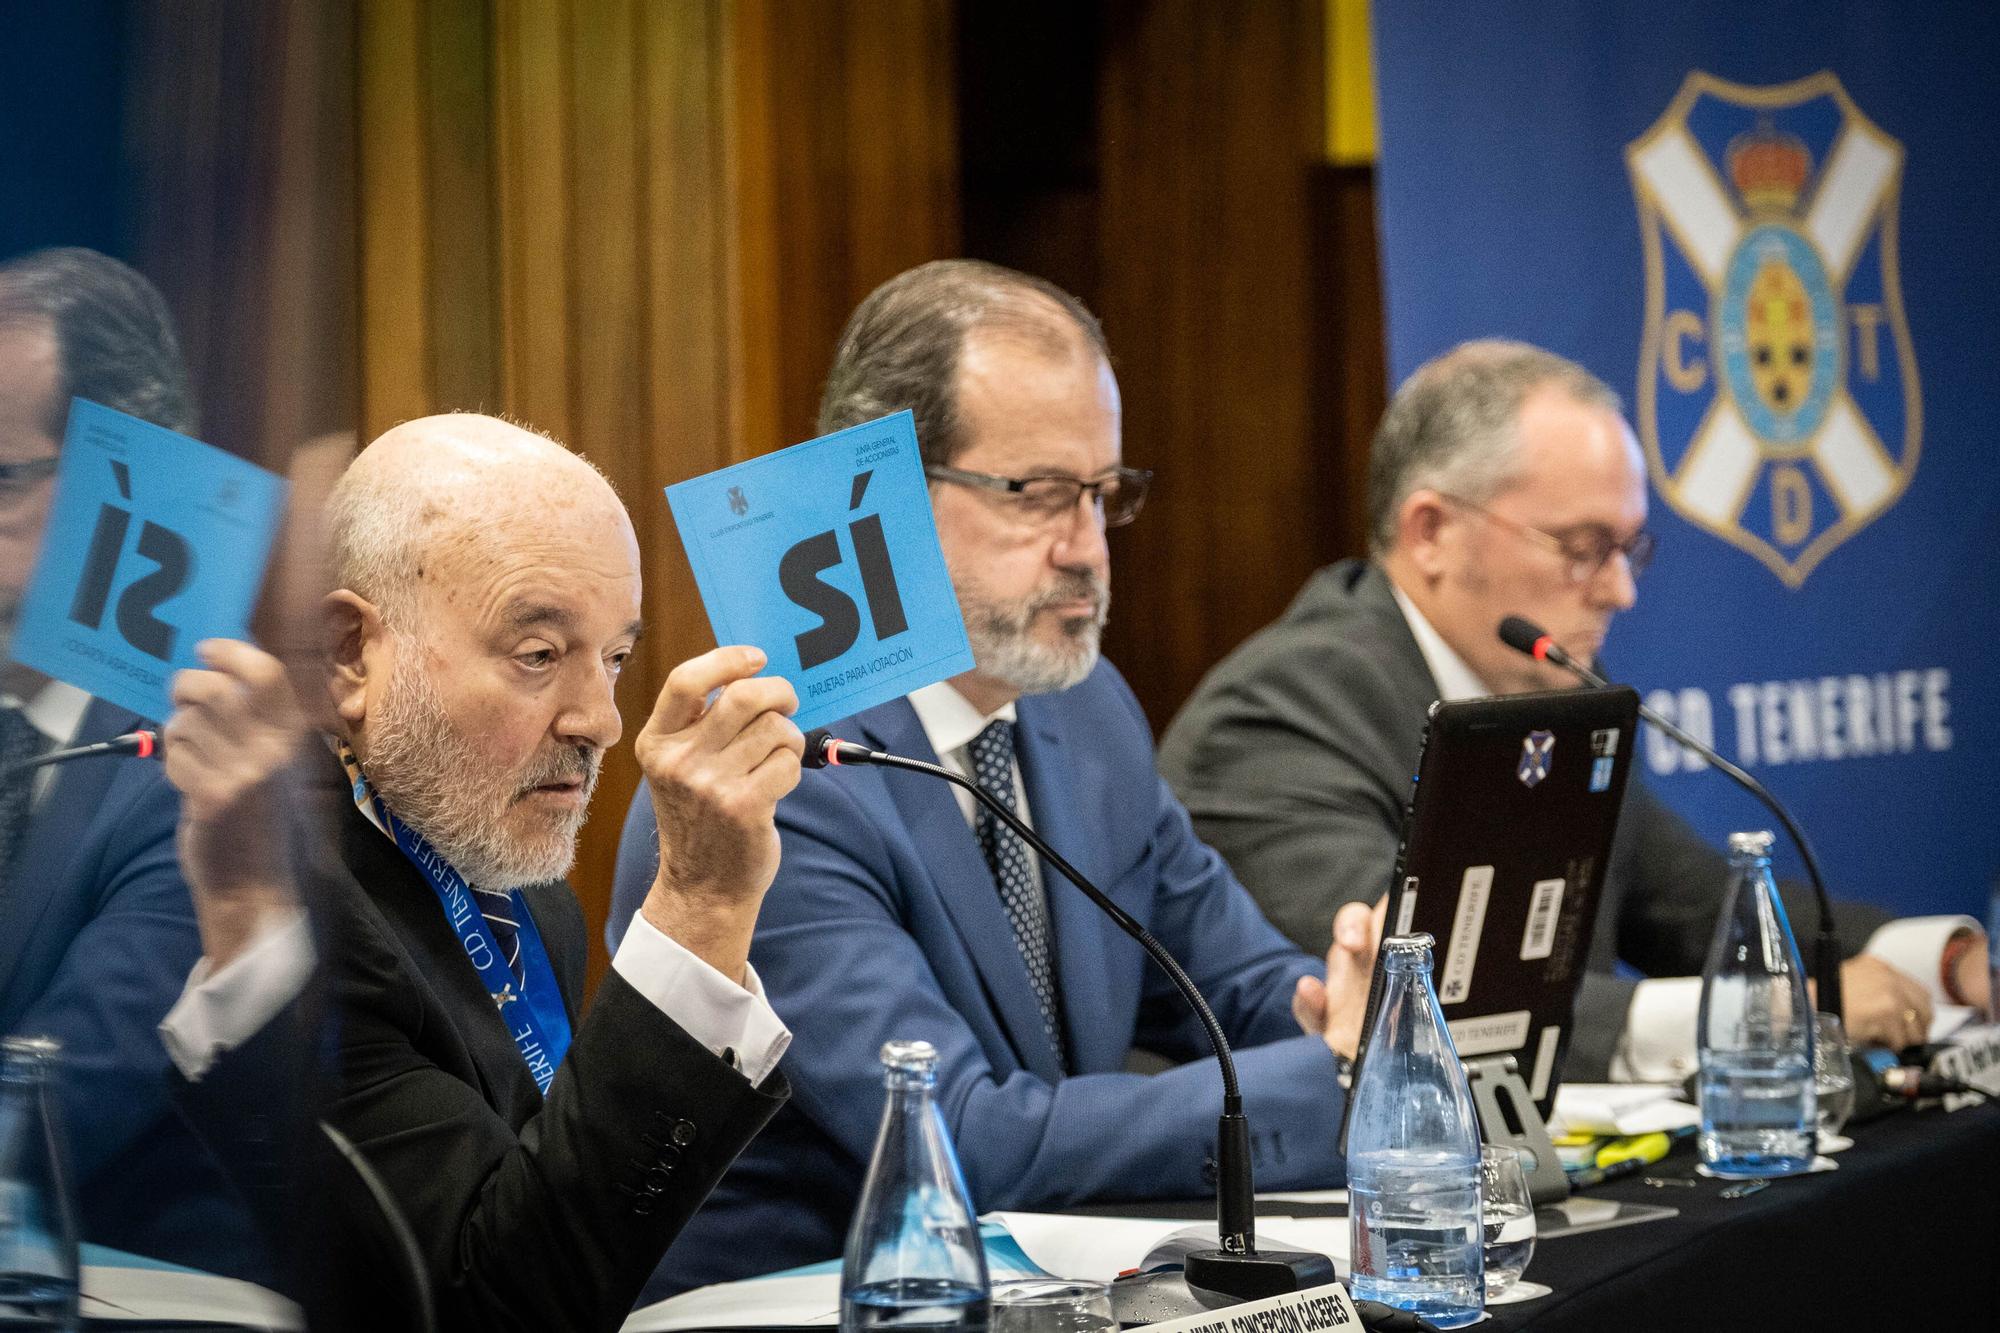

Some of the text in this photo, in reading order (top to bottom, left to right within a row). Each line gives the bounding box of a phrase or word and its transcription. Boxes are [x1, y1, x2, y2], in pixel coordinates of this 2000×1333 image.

[779, 469, 909, 671] SÍ
[807, 673, 846, 698] TARJETAS
[845, 665, 868, 683] PARA
[1646, 667, 1951, 775] CD TENERIFE
[409, 831, 472, 933] TENERIFE
[1297, 1294, 1350, 1333] CÁCERES
